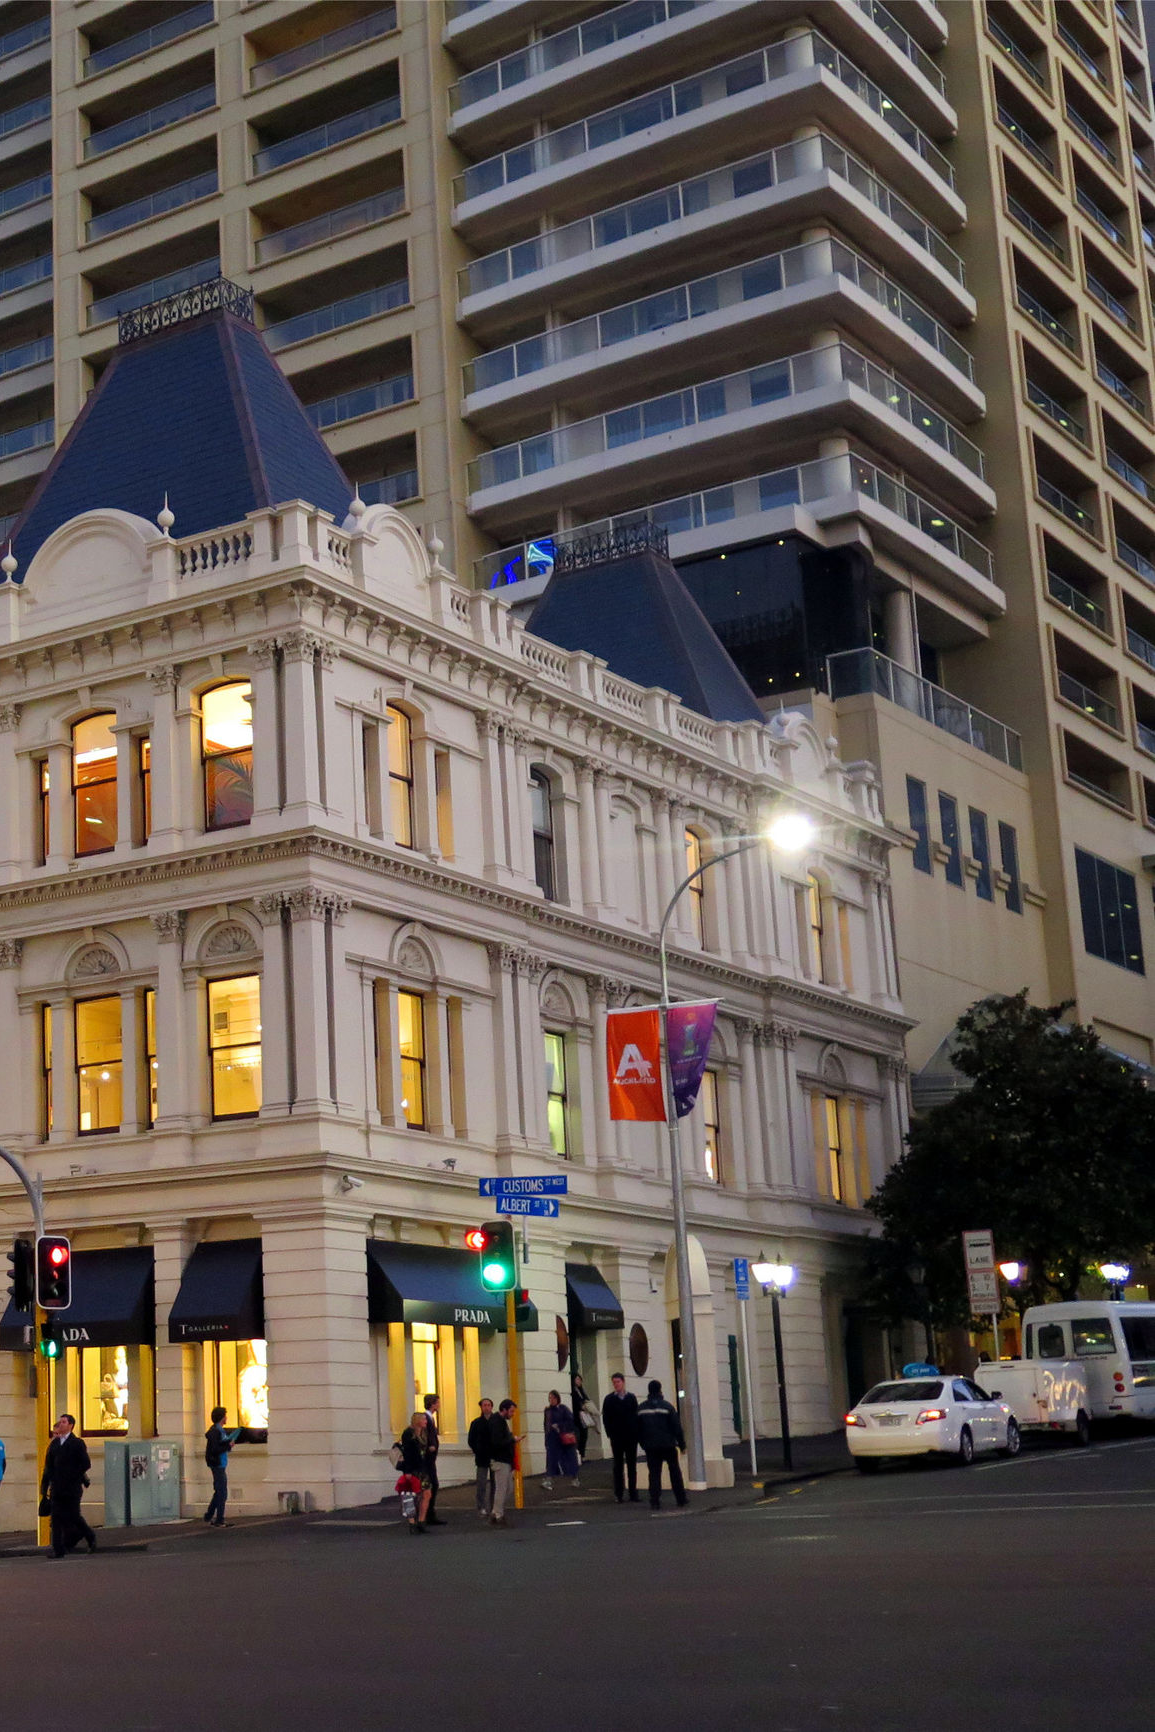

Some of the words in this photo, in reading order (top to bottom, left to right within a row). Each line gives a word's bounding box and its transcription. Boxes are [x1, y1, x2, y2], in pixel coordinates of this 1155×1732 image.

[502, 1179, 544, 1193] CUSTOMS
[500, 1198, 531, 1213] ALBERT
[454, 1308, 491, 1323] PRADA
